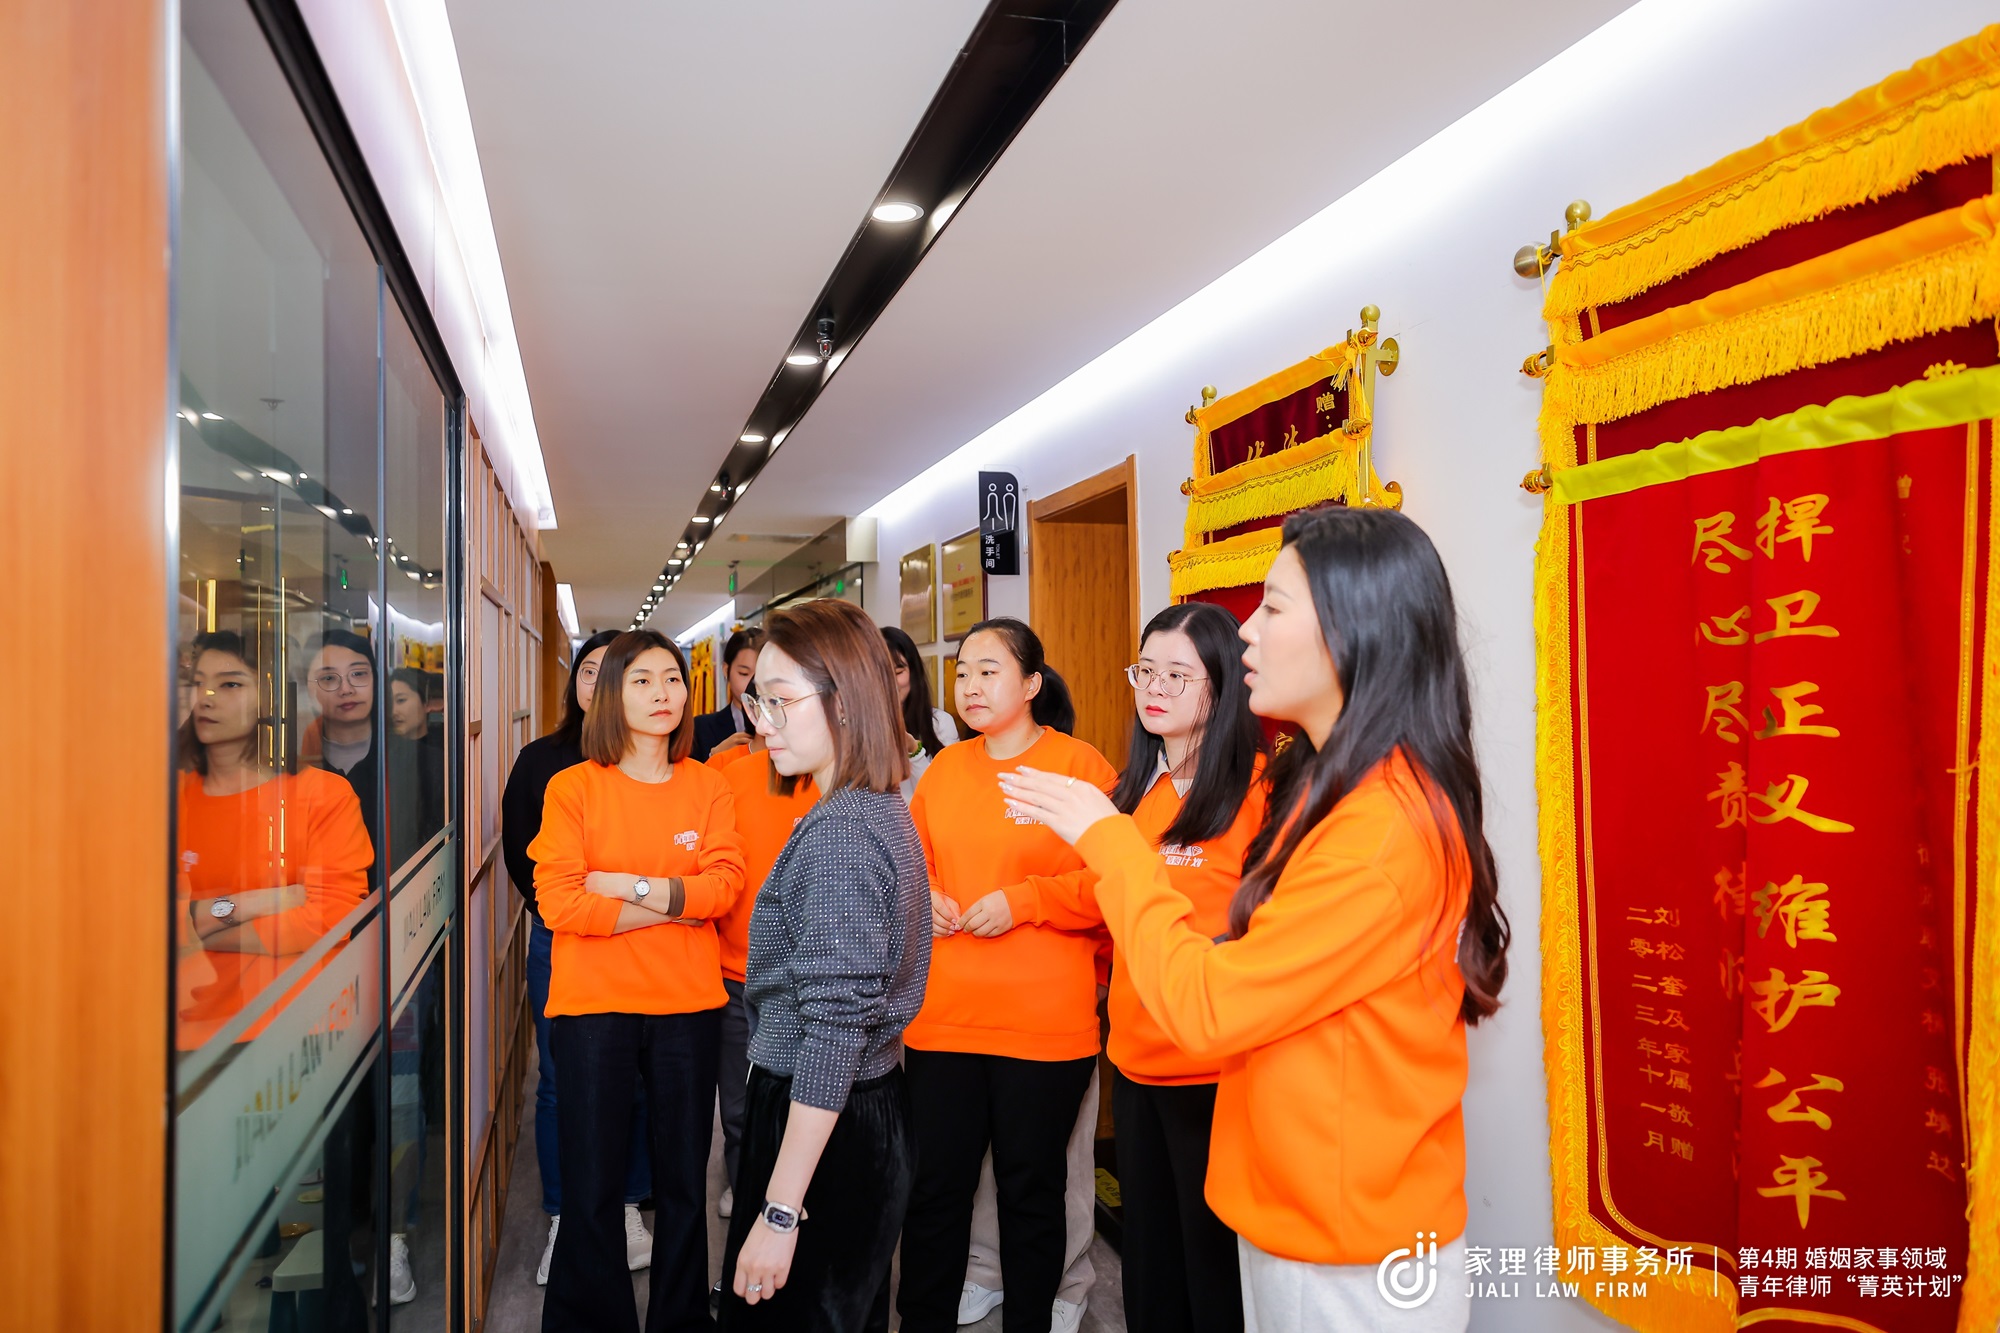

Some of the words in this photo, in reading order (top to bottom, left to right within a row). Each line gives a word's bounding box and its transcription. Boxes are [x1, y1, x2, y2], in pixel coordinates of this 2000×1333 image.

[985, 535, 995, 568] 洗手间
[1748, 493, 1855, 1229] 捍卫正义维护公平
[1626, 906, 1667, 1152] 二零二三年十一月
[1653, 906, 1694, 1161] 刘松奎及家属敬赠
